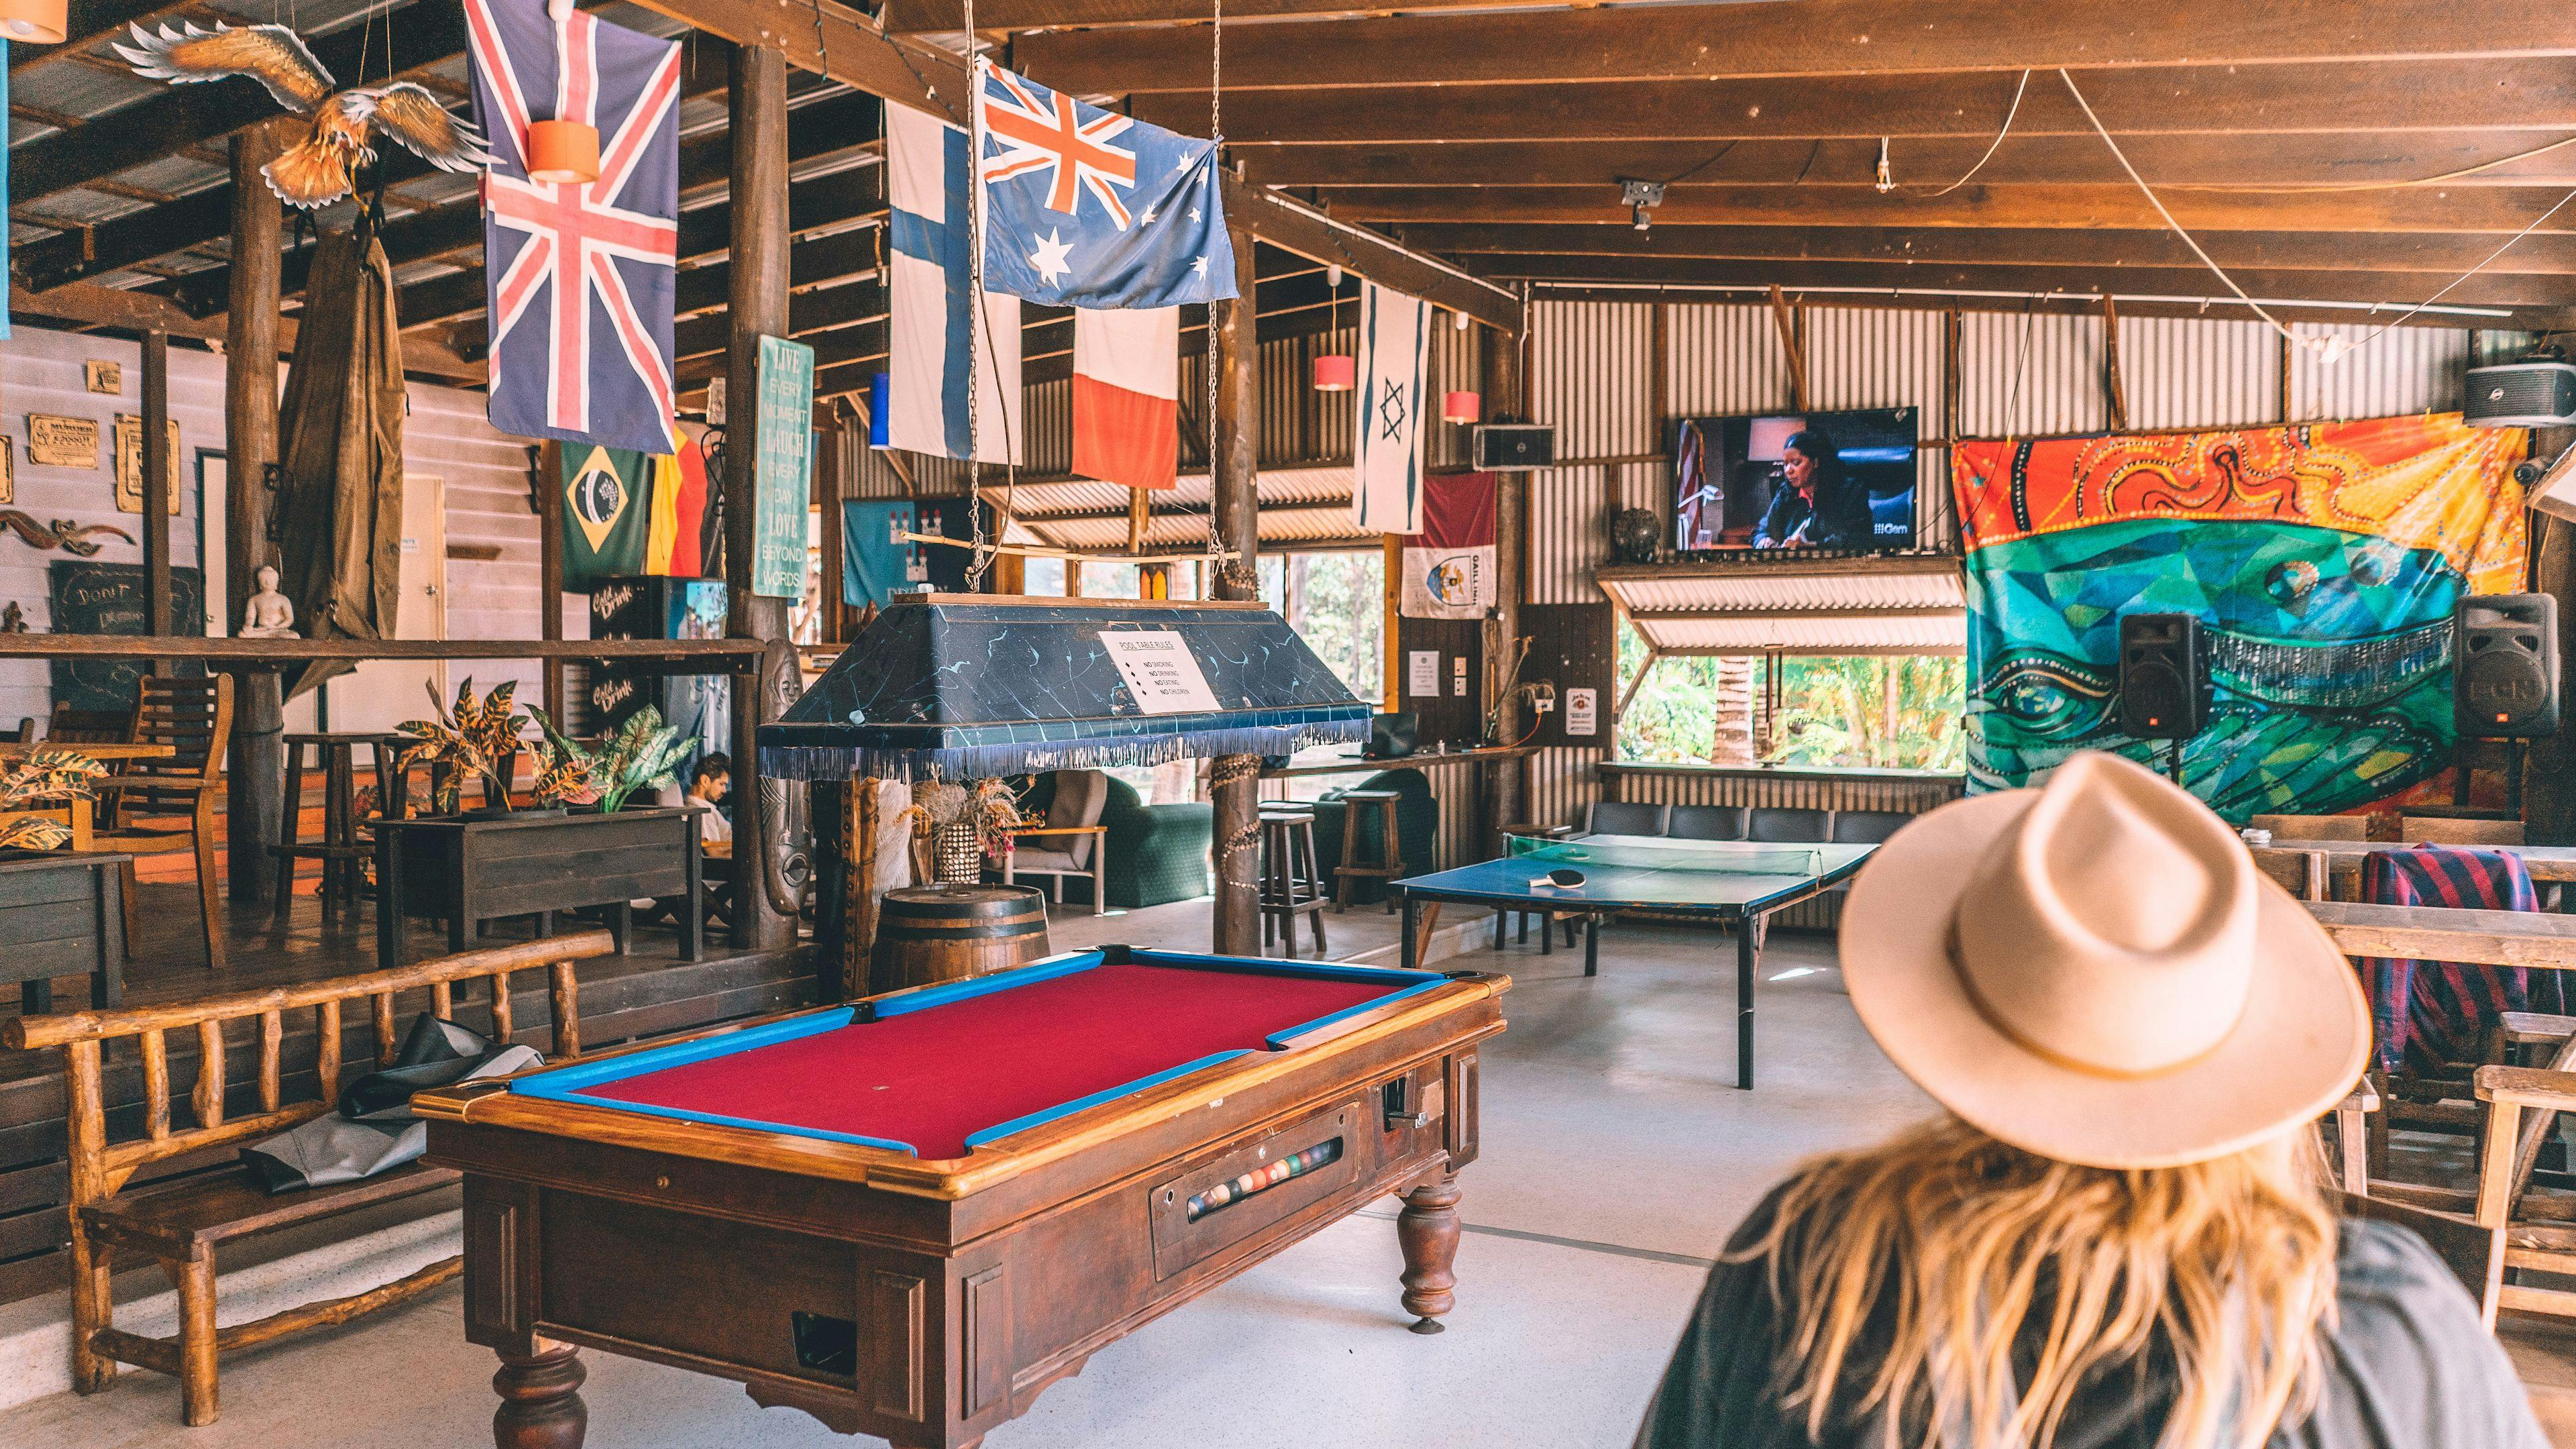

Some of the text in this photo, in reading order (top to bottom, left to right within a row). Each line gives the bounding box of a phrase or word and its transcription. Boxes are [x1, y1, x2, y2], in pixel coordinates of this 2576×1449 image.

[773, 345, 800, 374] LIVE
[769, 378, 802, 398] EVERY
[765, 404, 806, 424] MOMENT
[766, 428, 804, 457] LAUGH
[767, 461, 800, 479] EVERY
[774, 488, 794, 504] DAY
[768, 513, 798, 539] LOVE
[762, 545, 802, 563] BEYOND
[763, 572, 800, 588] WORDS
[593, 585, 612, 612] Cold
[601, 585, 633, 620] Drink
[1119, 641, 1138, 649] POOL
[593, 679, 612, 706] Cold
[601, 679, 633, 713] Drink
